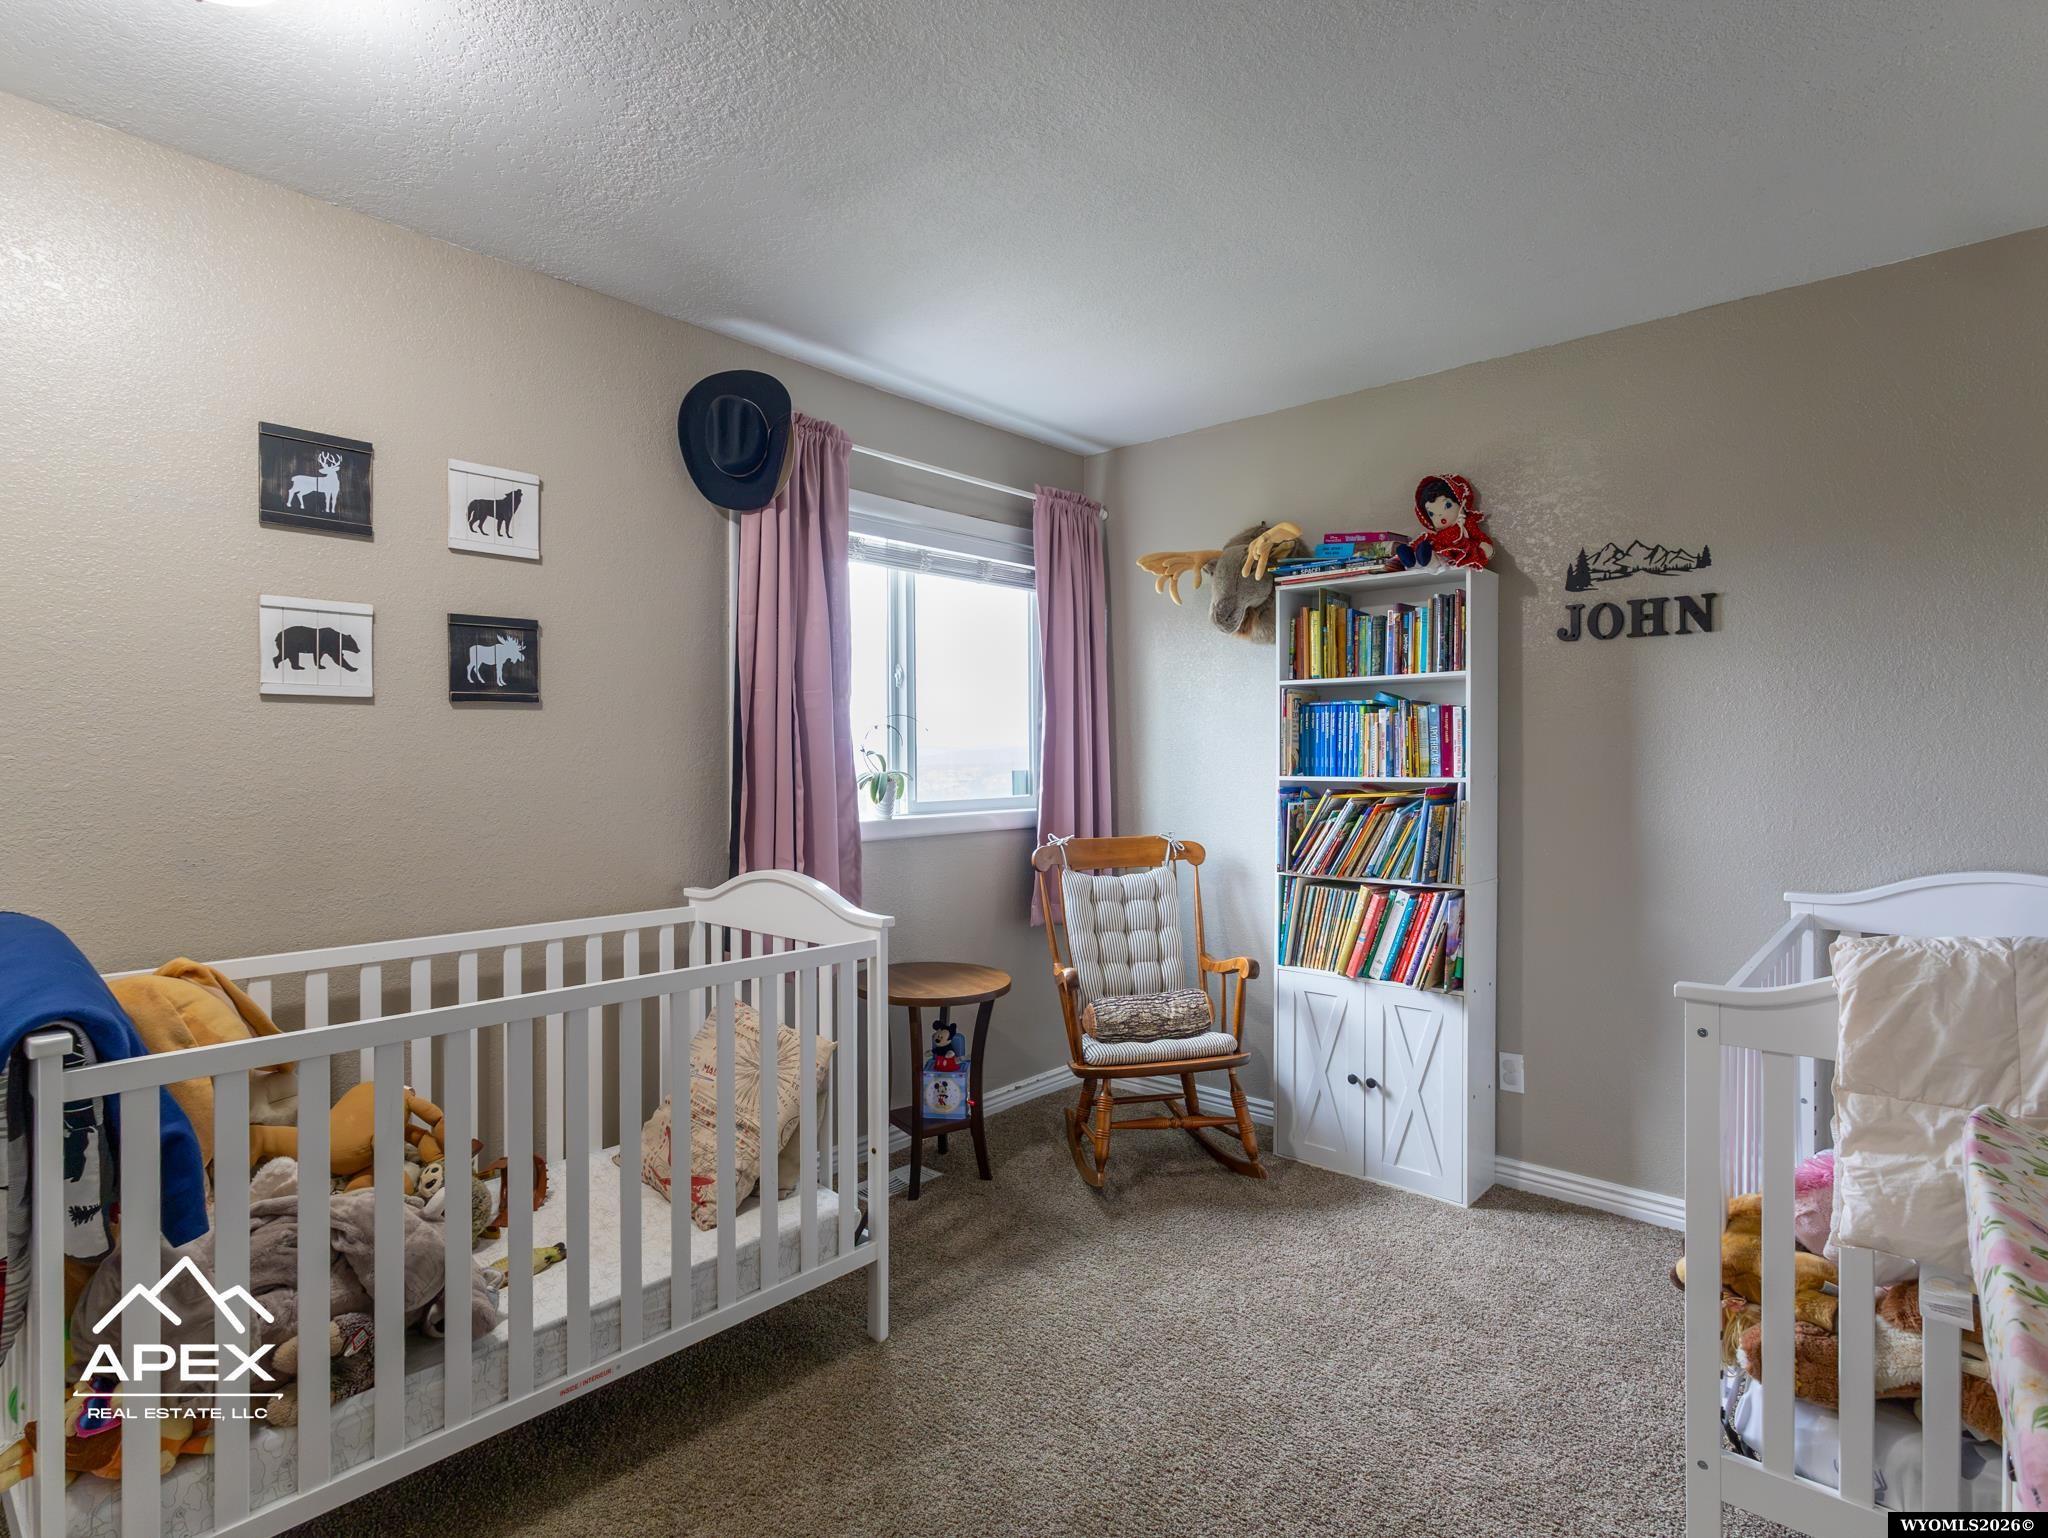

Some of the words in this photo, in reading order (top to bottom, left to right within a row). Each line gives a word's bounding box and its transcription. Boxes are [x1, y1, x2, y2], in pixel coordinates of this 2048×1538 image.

[1300, 567, 1320, 575] SPACE!
[1557, 593, 1717, 641] JOHN
[1430, 725, 1439, 765] APOTHECARY
